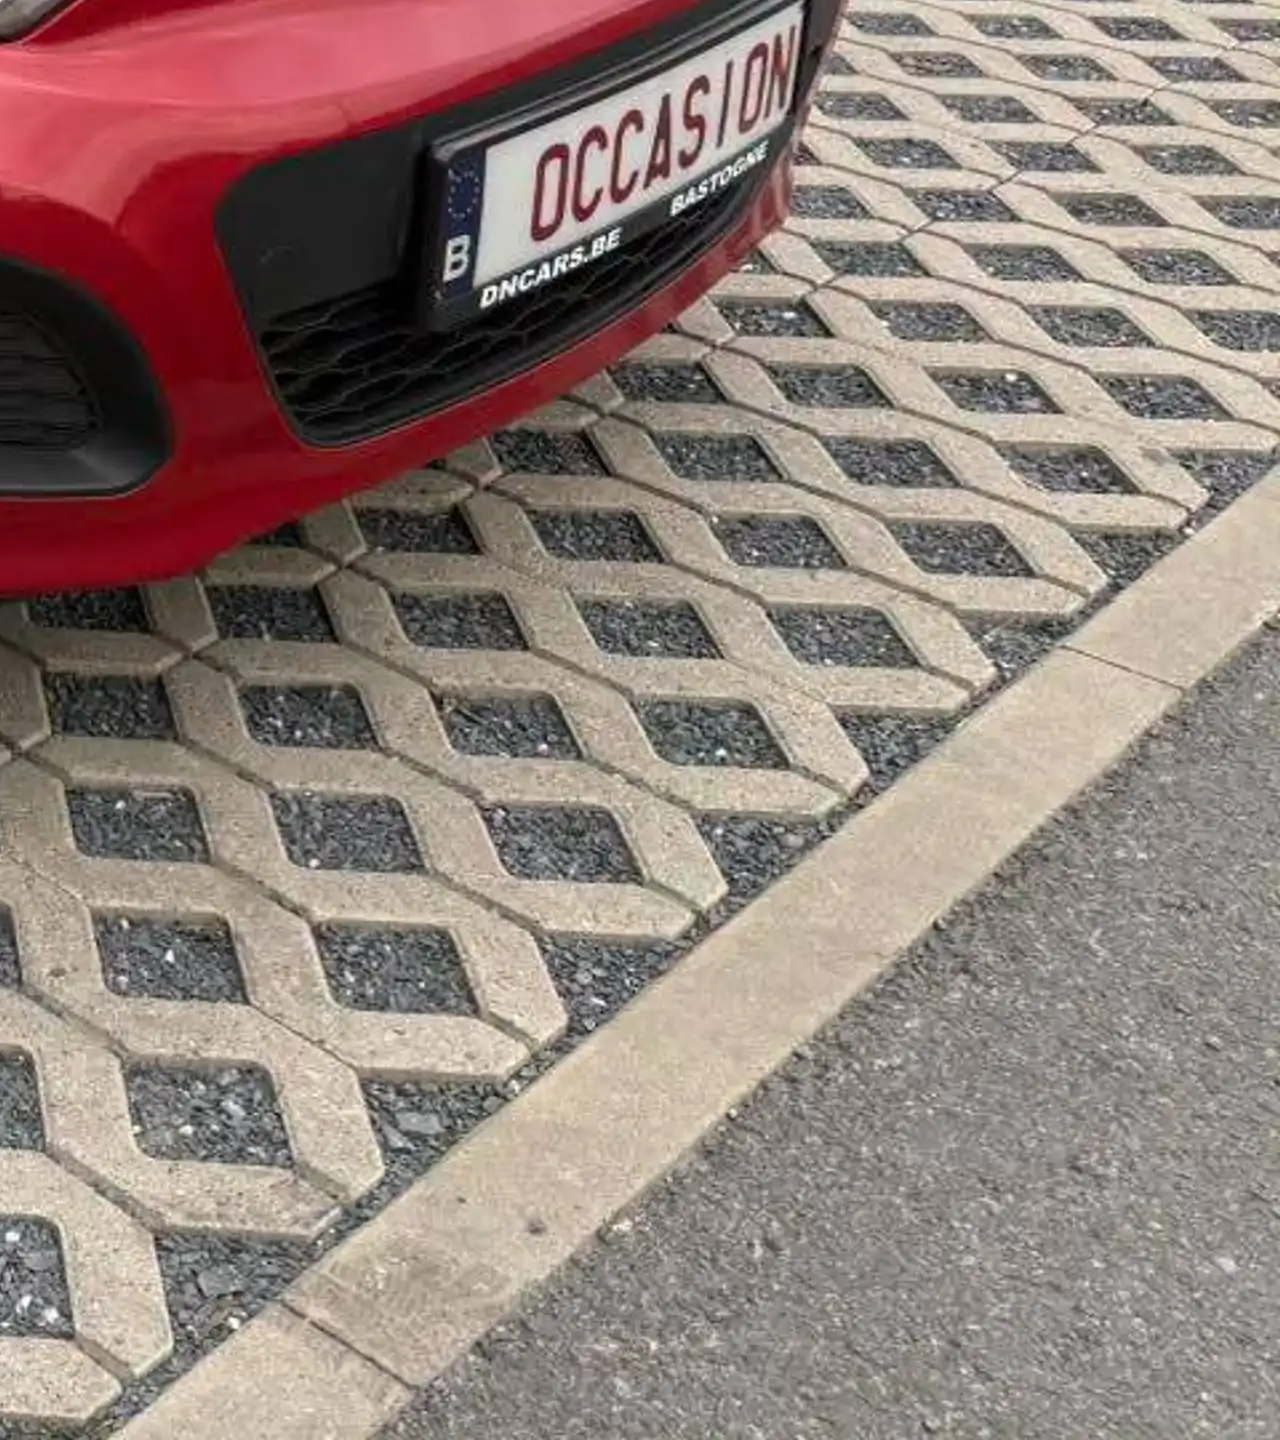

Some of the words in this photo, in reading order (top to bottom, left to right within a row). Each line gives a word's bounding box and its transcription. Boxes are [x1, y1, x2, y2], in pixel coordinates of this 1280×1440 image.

[530, 25, 797, 242] OCCASION
[443, 234, 471, 283] B
[479, 227, 622, 310] DNCARS.BE
[669, 140, 770, 217] BASTOGNE
